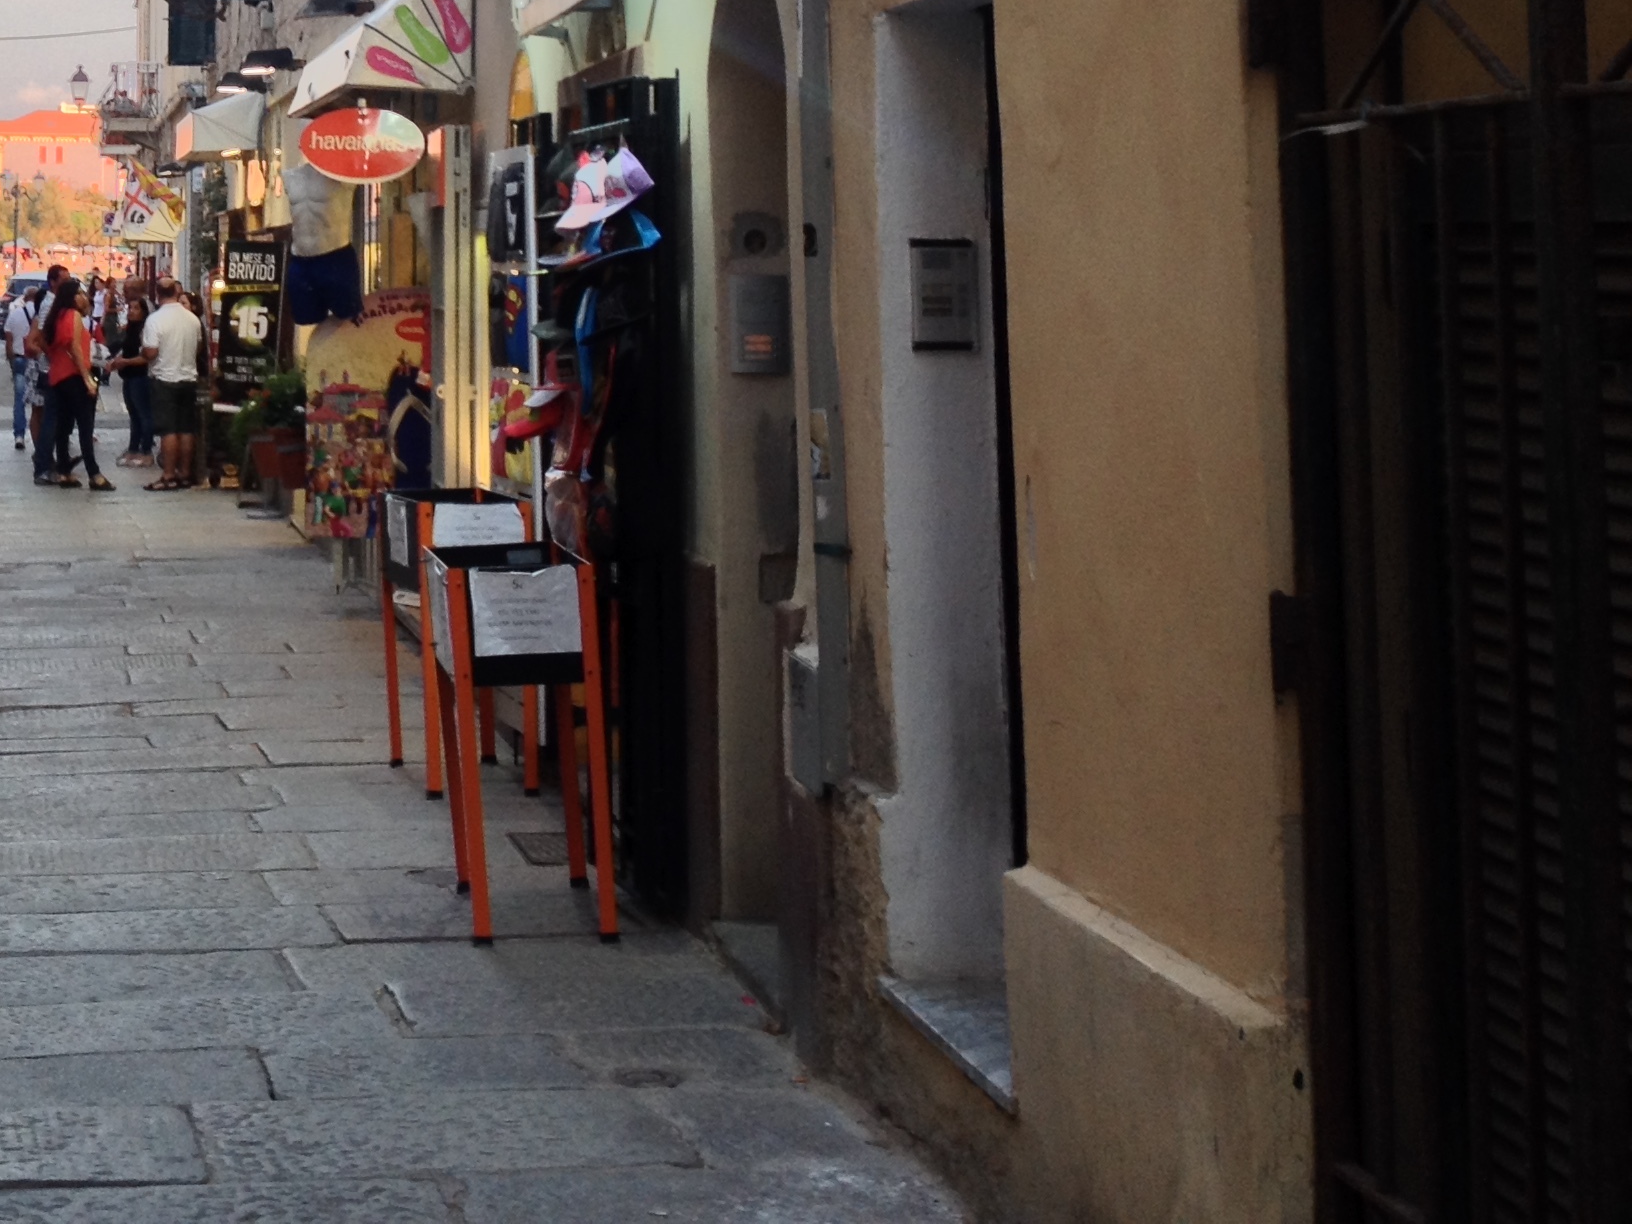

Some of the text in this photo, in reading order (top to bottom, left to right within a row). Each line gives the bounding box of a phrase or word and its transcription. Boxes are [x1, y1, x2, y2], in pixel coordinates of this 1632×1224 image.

[310, 130, 409, 153] havaianas
[228, 251, 276, 265] UN MESE DA
[228, 262, 276, 281] BRIVIDO
